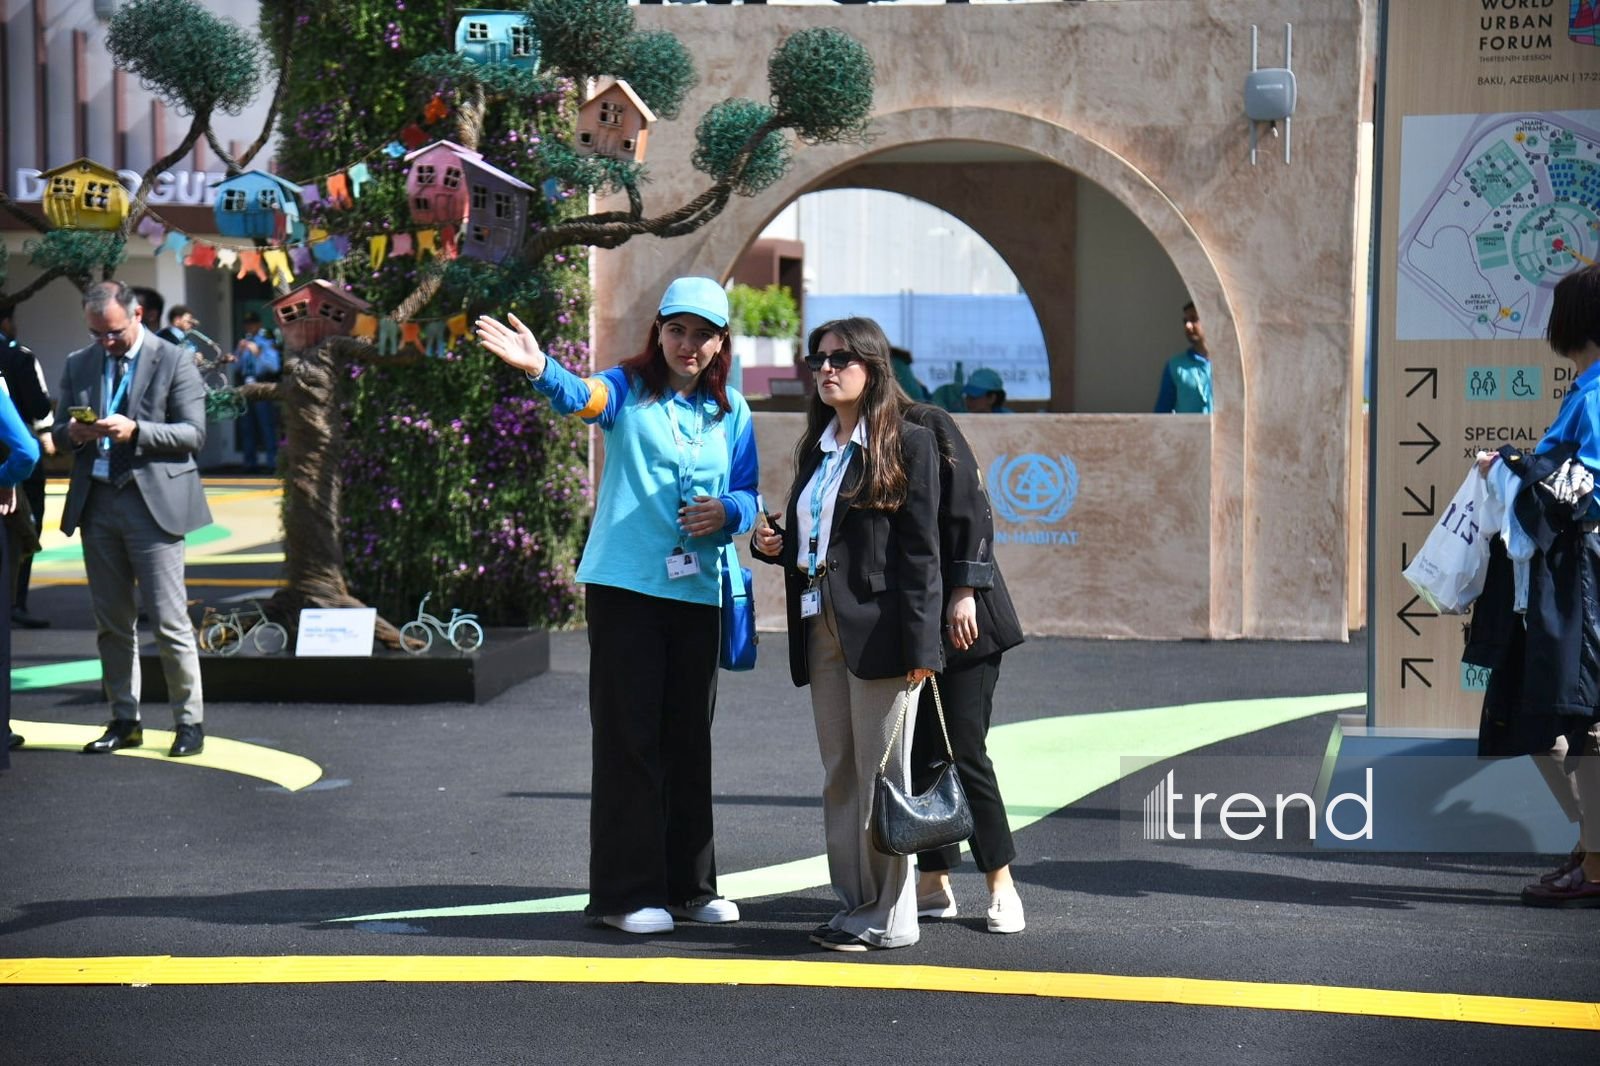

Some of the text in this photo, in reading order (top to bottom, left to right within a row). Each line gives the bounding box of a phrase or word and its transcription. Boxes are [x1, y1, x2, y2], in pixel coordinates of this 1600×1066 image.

[1480, 14, 1553, 30] URBAN
[1479, 34, 1553, 50] FORUM
[1477, 76, 1507, 86] BAKU,
[1509, 73, 1569, 85] AZERBAIJAN
[1464, 426, 1537, 441] SPECIAL
[995, 530, 1079, 545] N-HABITAT
